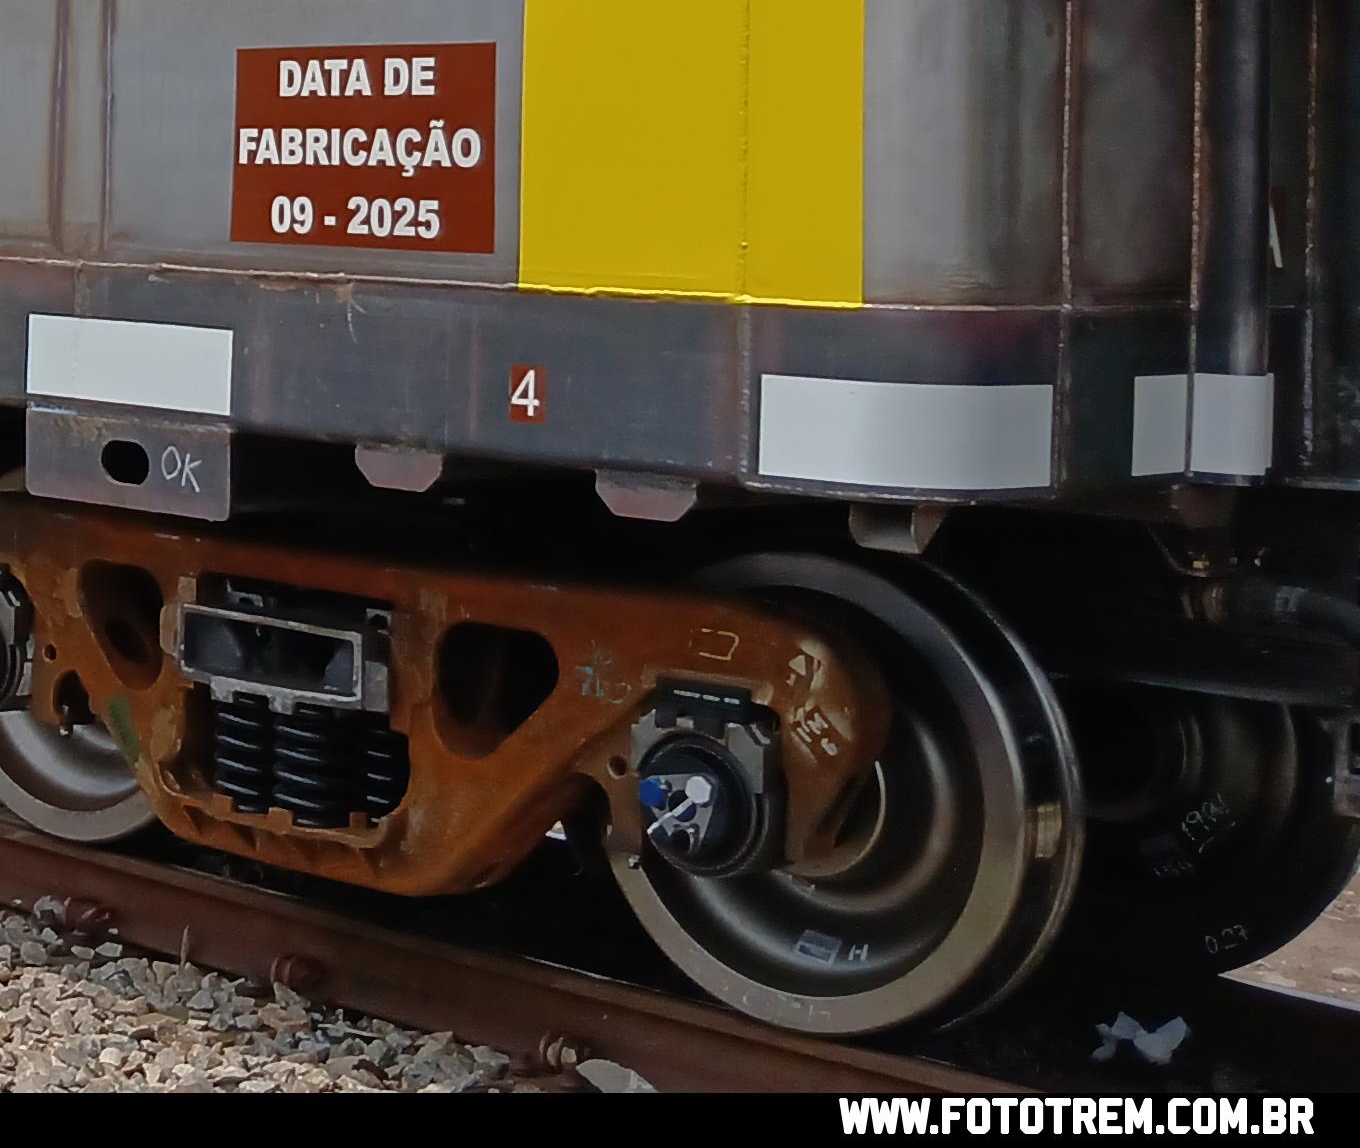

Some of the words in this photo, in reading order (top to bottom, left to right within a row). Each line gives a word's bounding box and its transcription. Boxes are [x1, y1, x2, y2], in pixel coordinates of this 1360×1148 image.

[279, 59, 373, 97] DATA
[384, 57, 436, 95] DE
[238, 119, 481, 177] FABRICAÇÃO
[270, 195, 313, 234] 09
[347, 196, 440, 239] 2025
[511, 369, 540, 416] 4
[161, 445, 202, 493] OK
